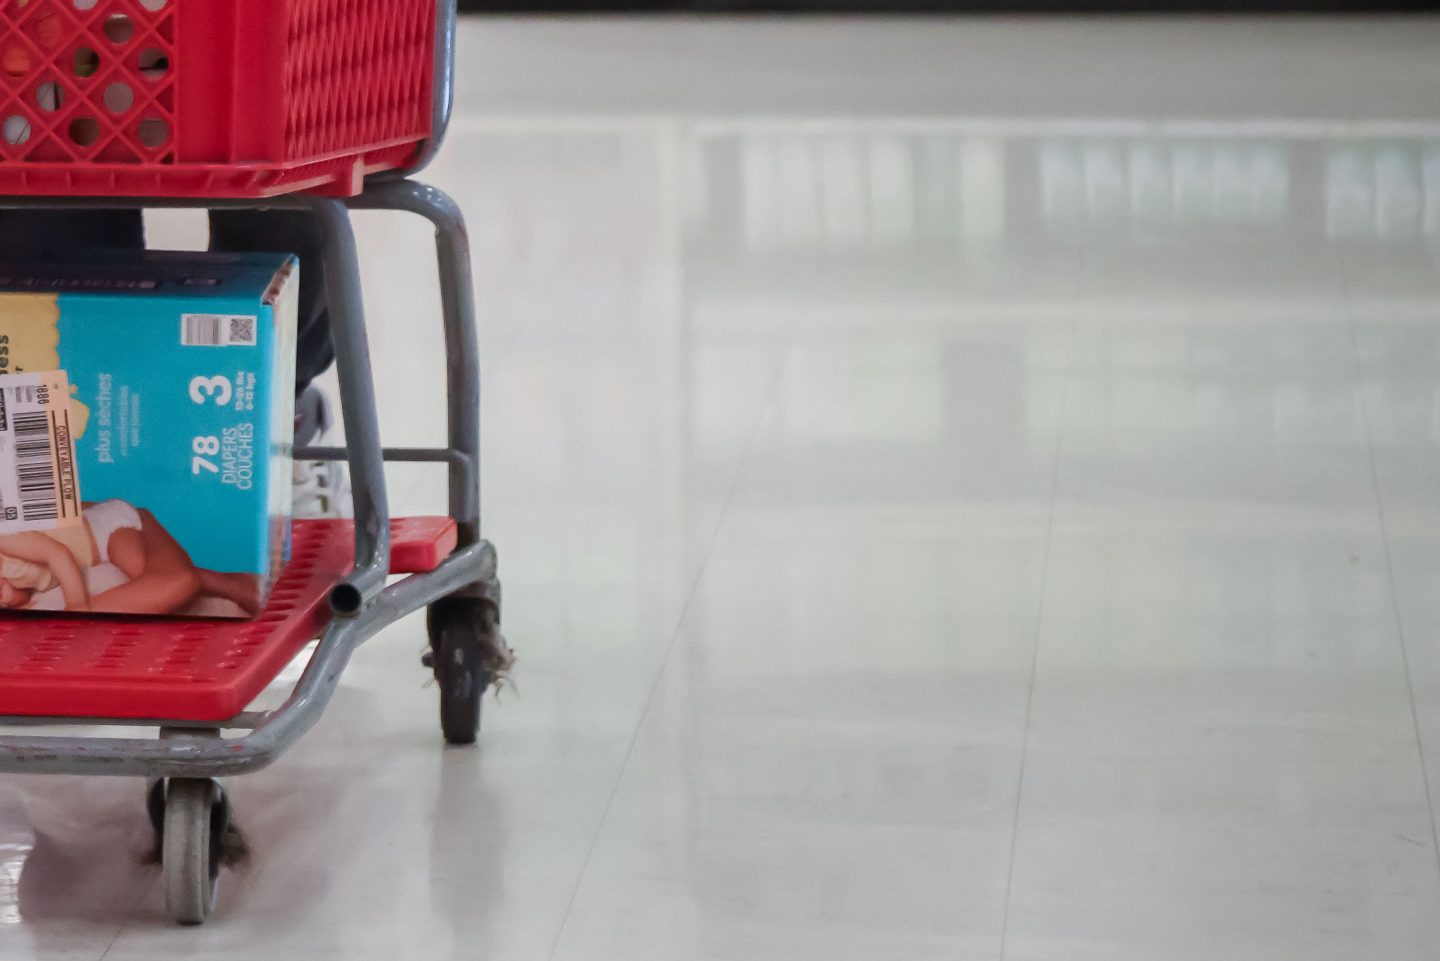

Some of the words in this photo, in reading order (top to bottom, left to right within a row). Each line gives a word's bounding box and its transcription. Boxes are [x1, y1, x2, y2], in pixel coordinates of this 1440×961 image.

[188, 375, 233, 406] 3
[94, 430, 114, 463] plus
[191, 435, 220, 475] 78
[222, 427, 238, 484] DIAPERS
[236, 422, 254, 490] COUCHES
